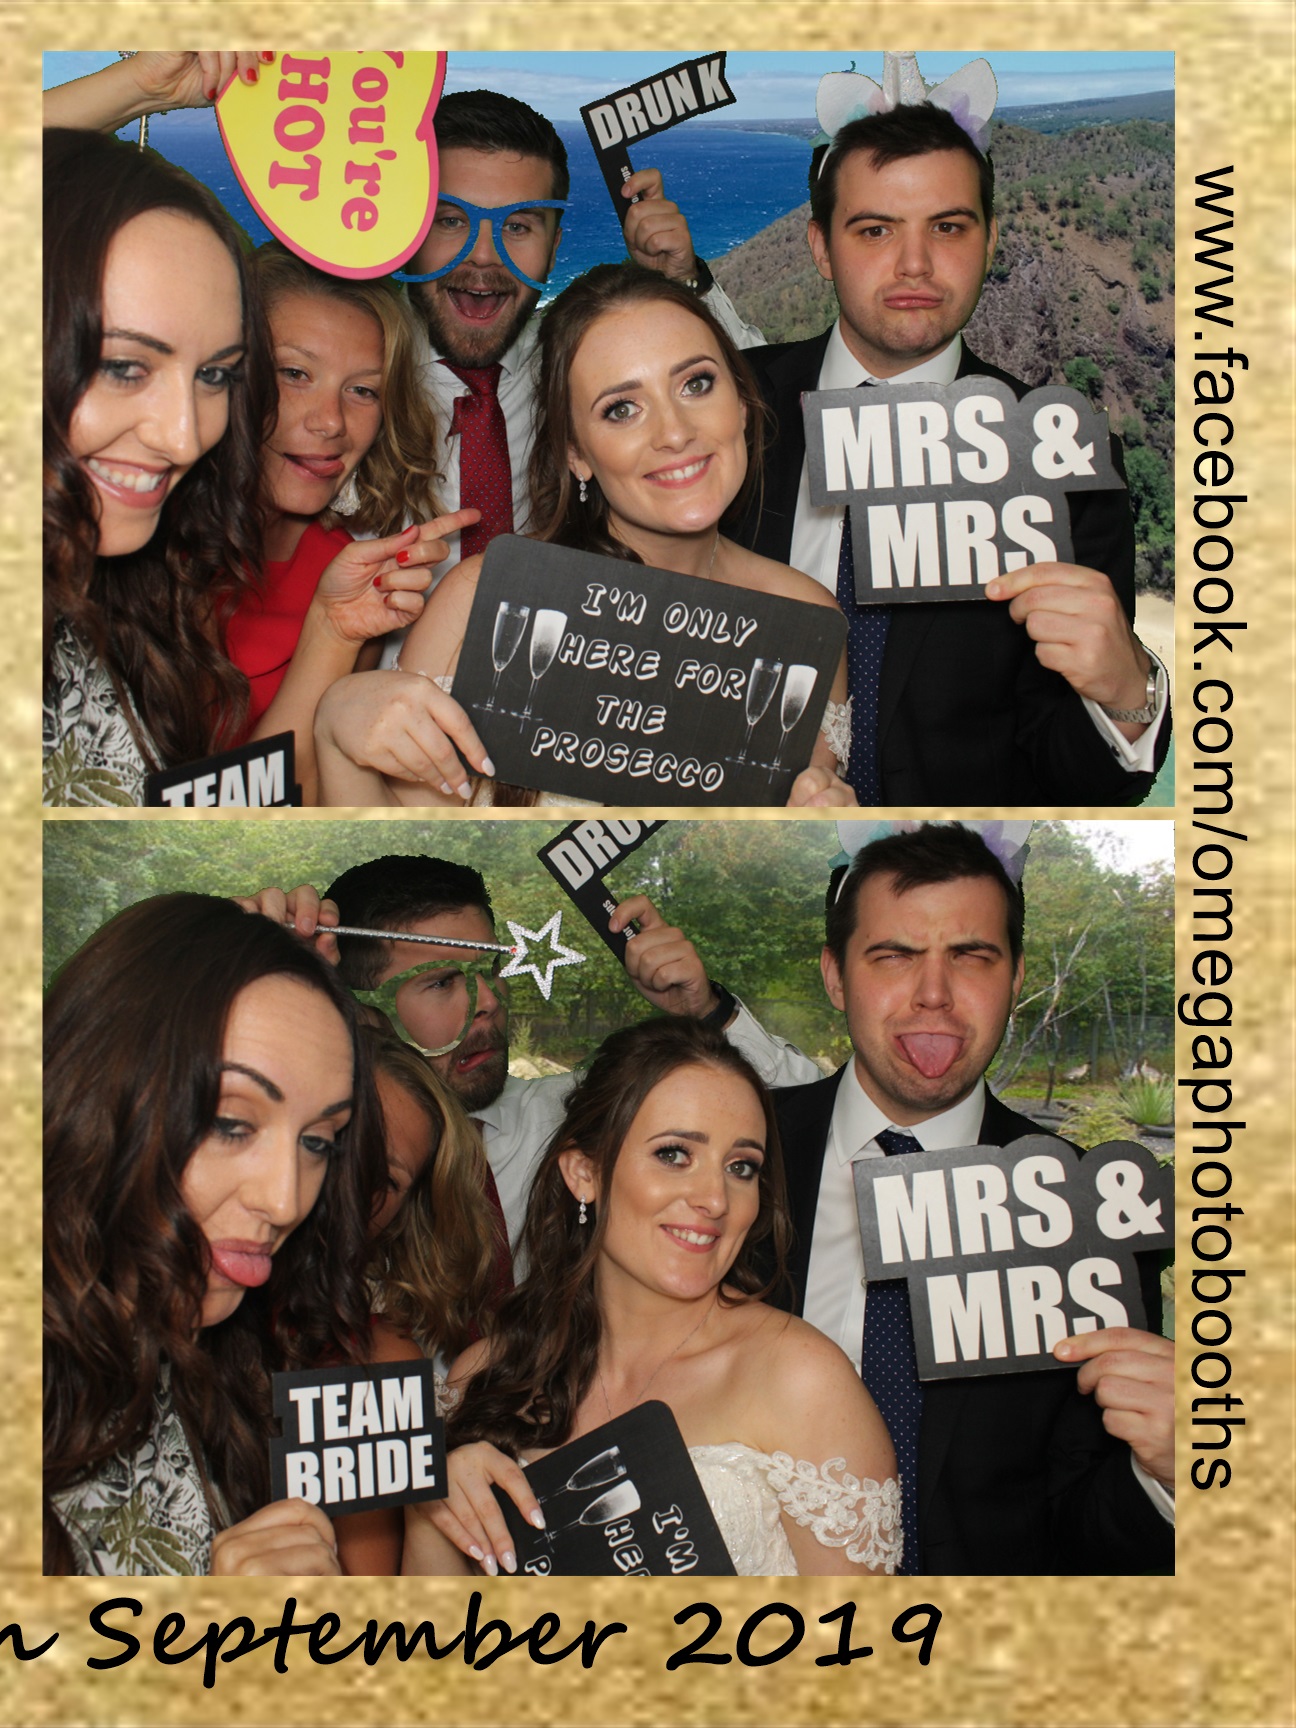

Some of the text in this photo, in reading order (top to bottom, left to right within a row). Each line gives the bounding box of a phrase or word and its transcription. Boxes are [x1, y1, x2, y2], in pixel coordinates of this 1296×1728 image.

[268, 53, 331, 202] HOT
[588, 58, 729, 150] DRUNK
[821, 395, 1097, 492] MRS &
[867, 495, 1057, 589] MRS
[581, 583, 758, 647] I'M ONLY
[558, 632, 746, 700] HERE FOR
[597, 695, 667, 734] THE
[531, 727, 724, 792] PROSECCO
[873, 1155, 1165, 1264] MRS &
[926, 1257, 1129, 1364] MRS
[289, 1375, 424, 1444] TEAM
[286, 1434, 435, 1506] BRIDE
[652, 1504, 699, 1574] I'M
